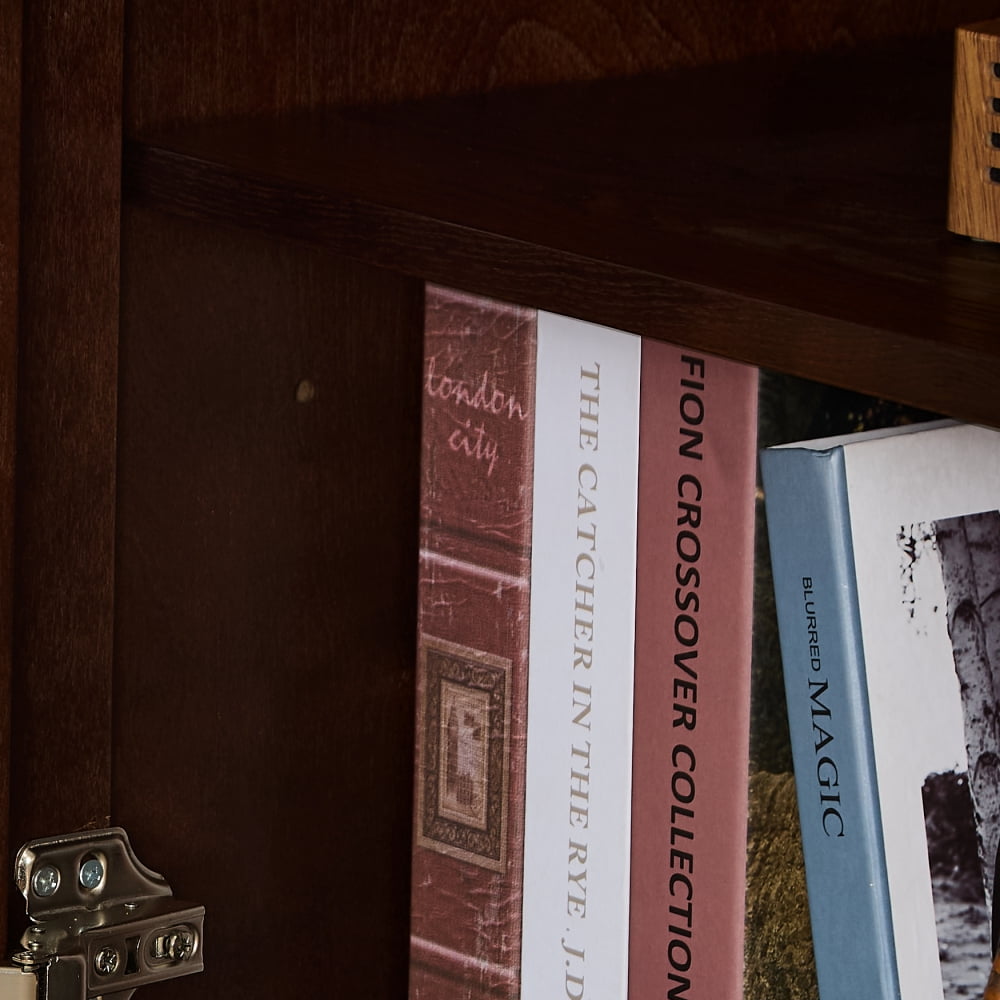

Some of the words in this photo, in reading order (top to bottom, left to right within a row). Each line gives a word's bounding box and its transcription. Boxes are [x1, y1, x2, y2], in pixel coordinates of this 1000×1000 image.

[448, 419, 499, 477] city
[579, 361, 601, 452] THE
[678, 354, 705, 462] FION
[572, 463, 598, 671] CATCHER
[672, 473, 703, 732] CROSSOVER
[802, 576, 822, 672] BLURRED
[571, 680, 593, 732] IN
[569, 740, 592, 829] THE
[808, 677, 845, 838] MAGIC
